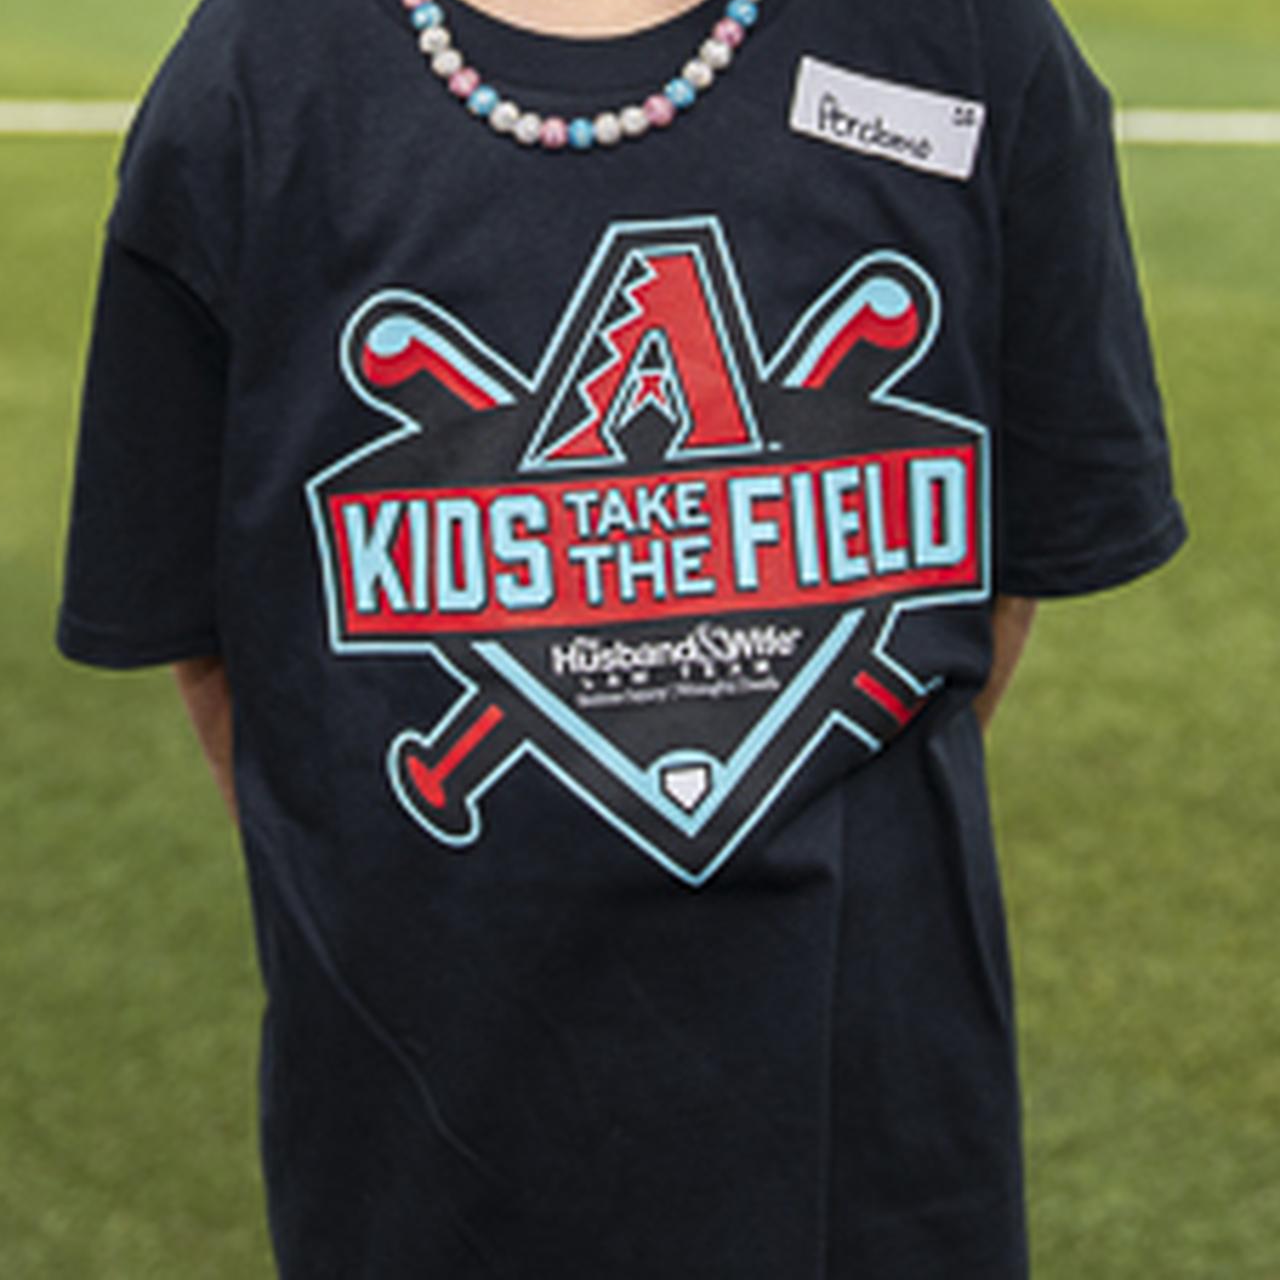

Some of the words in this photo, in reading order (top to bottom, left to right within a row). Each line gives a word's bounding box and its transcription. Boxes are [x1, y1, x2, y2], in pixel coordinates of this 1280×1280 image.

[341, 494, 554, 614] KIDS
[563, 481, 711, 537] TAKE
[728, 457, 968, 592] FIELD
[568, 535, 716, 606] THE
